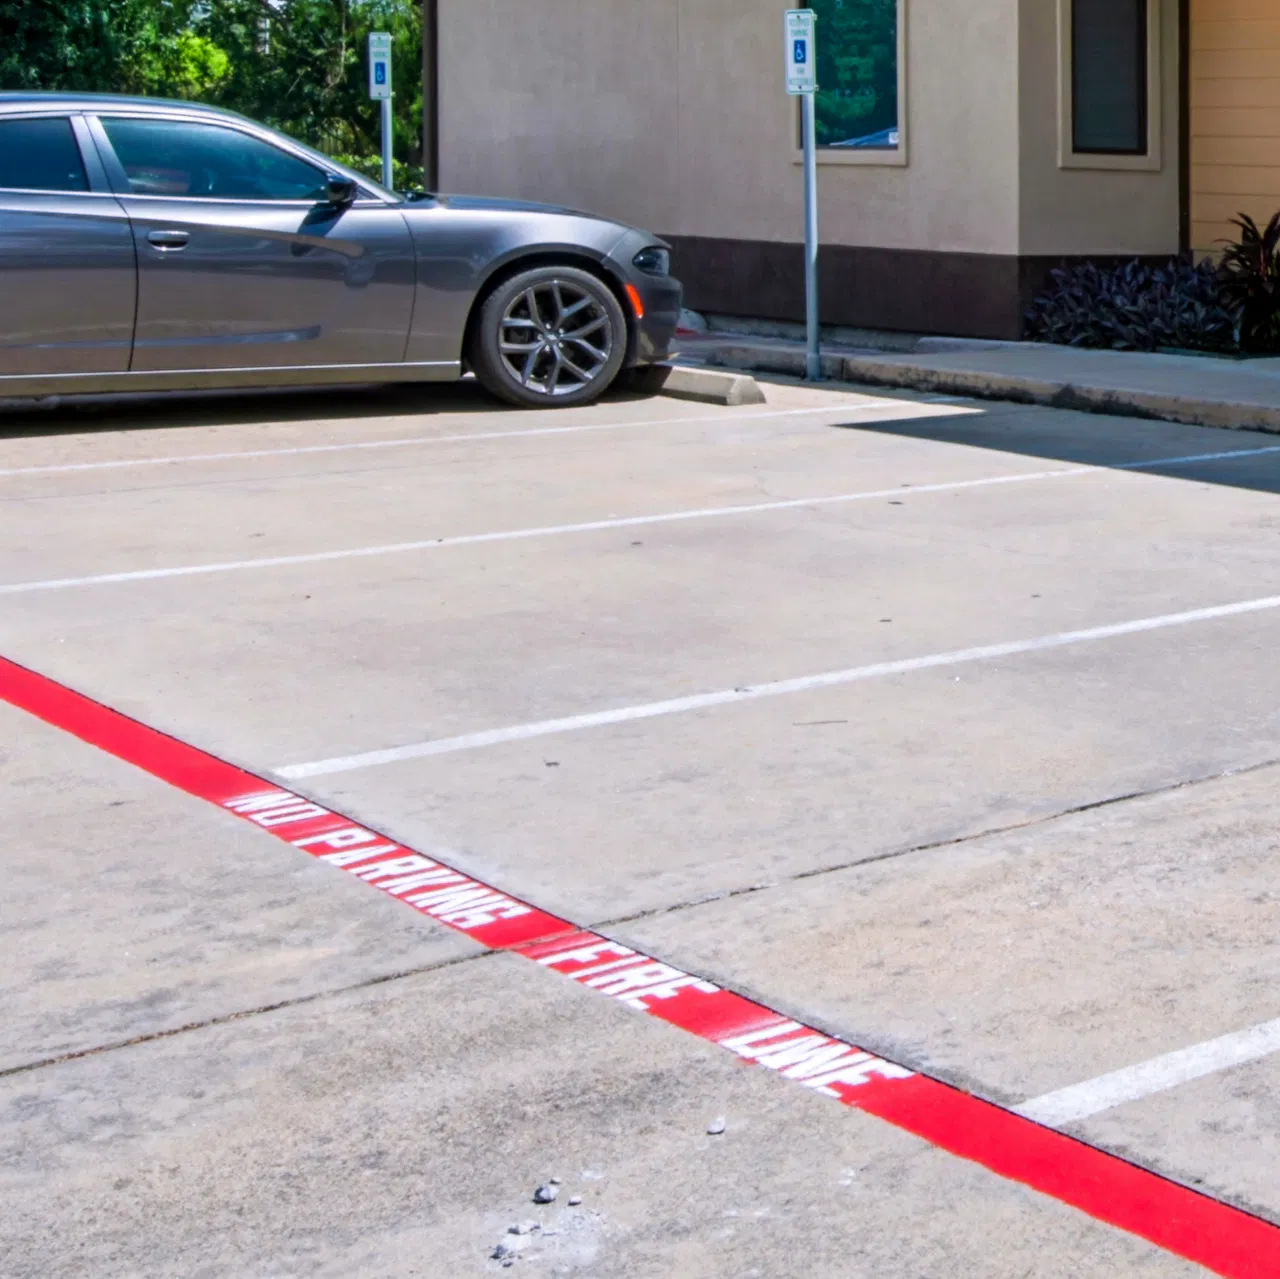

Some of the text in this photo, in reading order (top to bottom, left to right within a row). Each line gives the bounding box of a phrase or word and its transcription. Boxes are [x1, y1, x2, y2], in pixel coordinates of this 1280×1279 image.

[223, 790, 916, 1099] NO PARKING FIRE LANE
